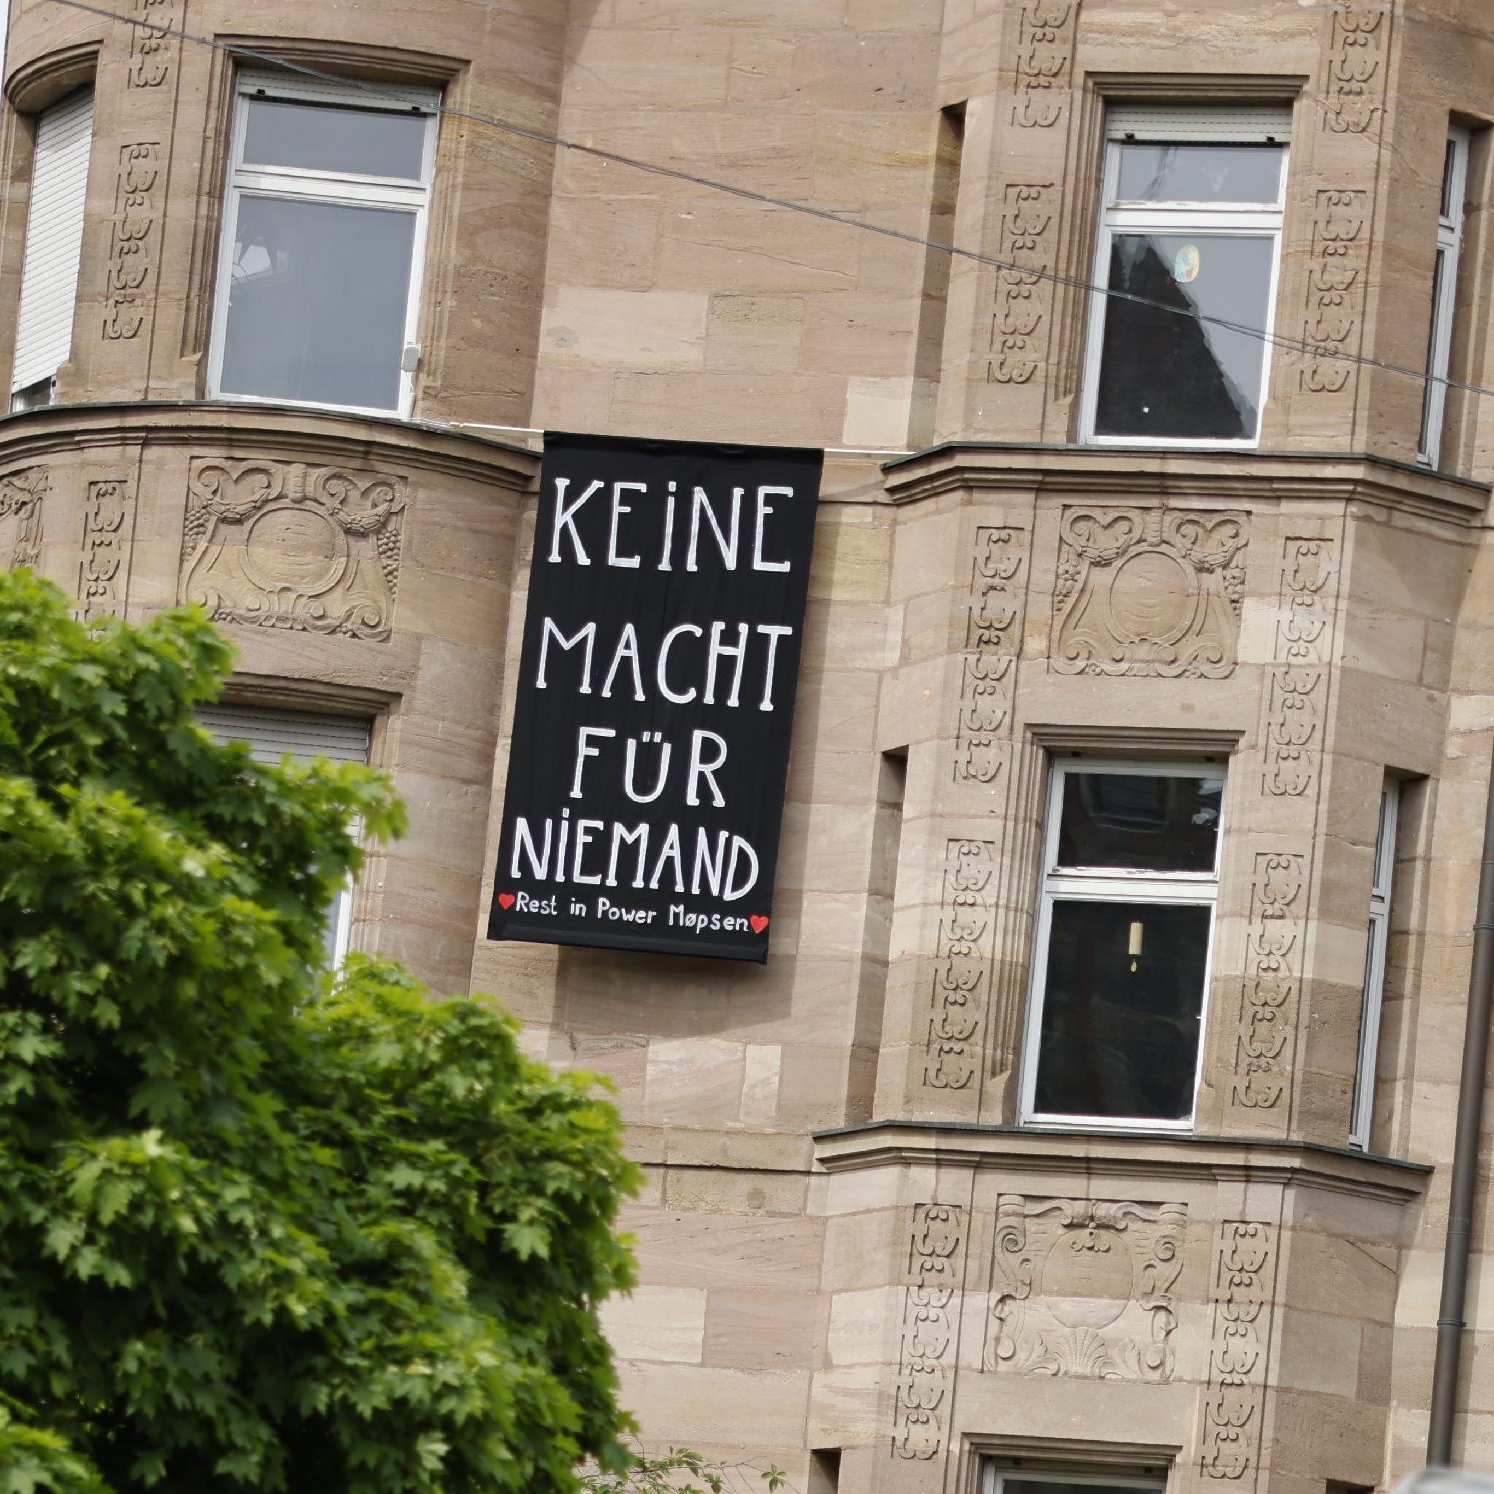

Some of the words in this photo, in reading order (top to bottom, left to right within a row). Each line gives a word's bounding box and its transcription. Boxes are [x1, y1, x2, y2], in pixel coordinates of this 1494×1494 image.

[536, 617, 793, 711] MACHT
[569, 726, 728, 808] FÜR
[515, 891, 558, 916] Rest
[570, 897, 587, 917] in
[597, 897, 657, 924] Power
[668, 904, 750, 934] Møpsen
